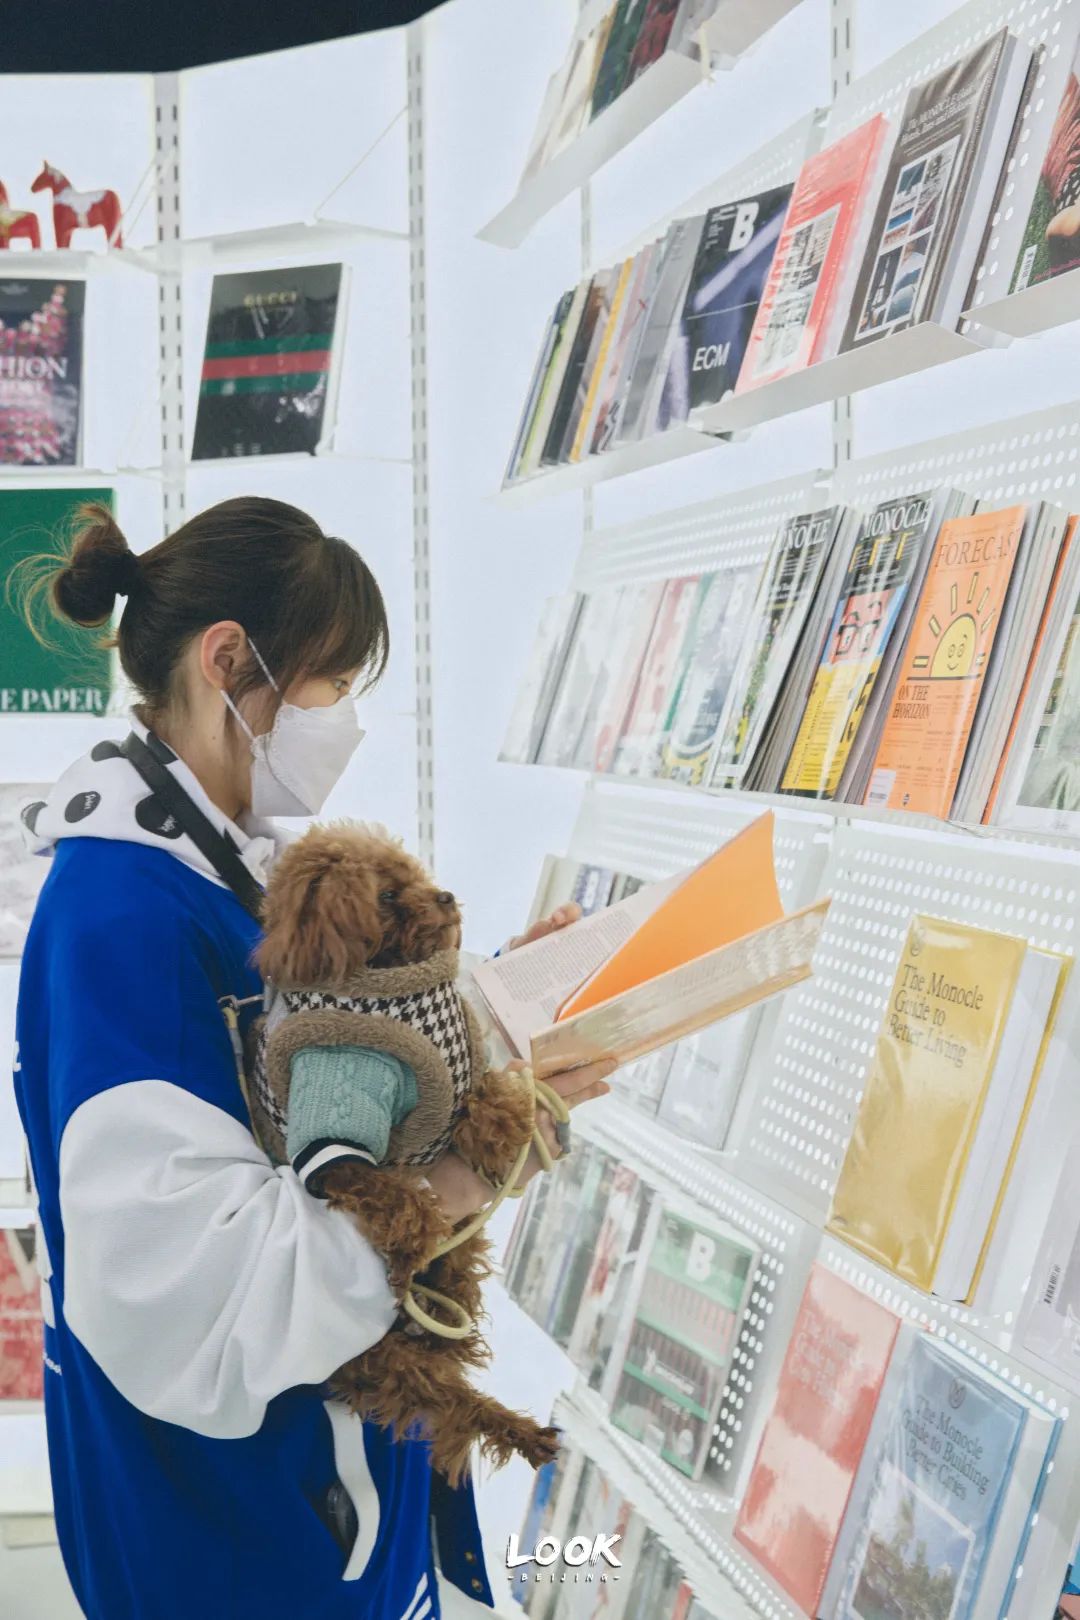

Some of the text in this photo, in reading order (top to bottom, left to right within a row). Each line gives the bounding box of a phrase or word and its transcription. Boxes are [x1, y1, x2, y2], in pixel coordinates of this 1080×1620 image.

[728, 202, 759, 253] B
[692, 342, 730, 371] ECM
[22, 687, 104, 712] PAPER
[895, 989, 946, 1027] Guide to
[902, 964, 984, 1010] The Monocle
[686, 1231, 717, 1282] B
[936, 1411, 984, 1461] Monocle
